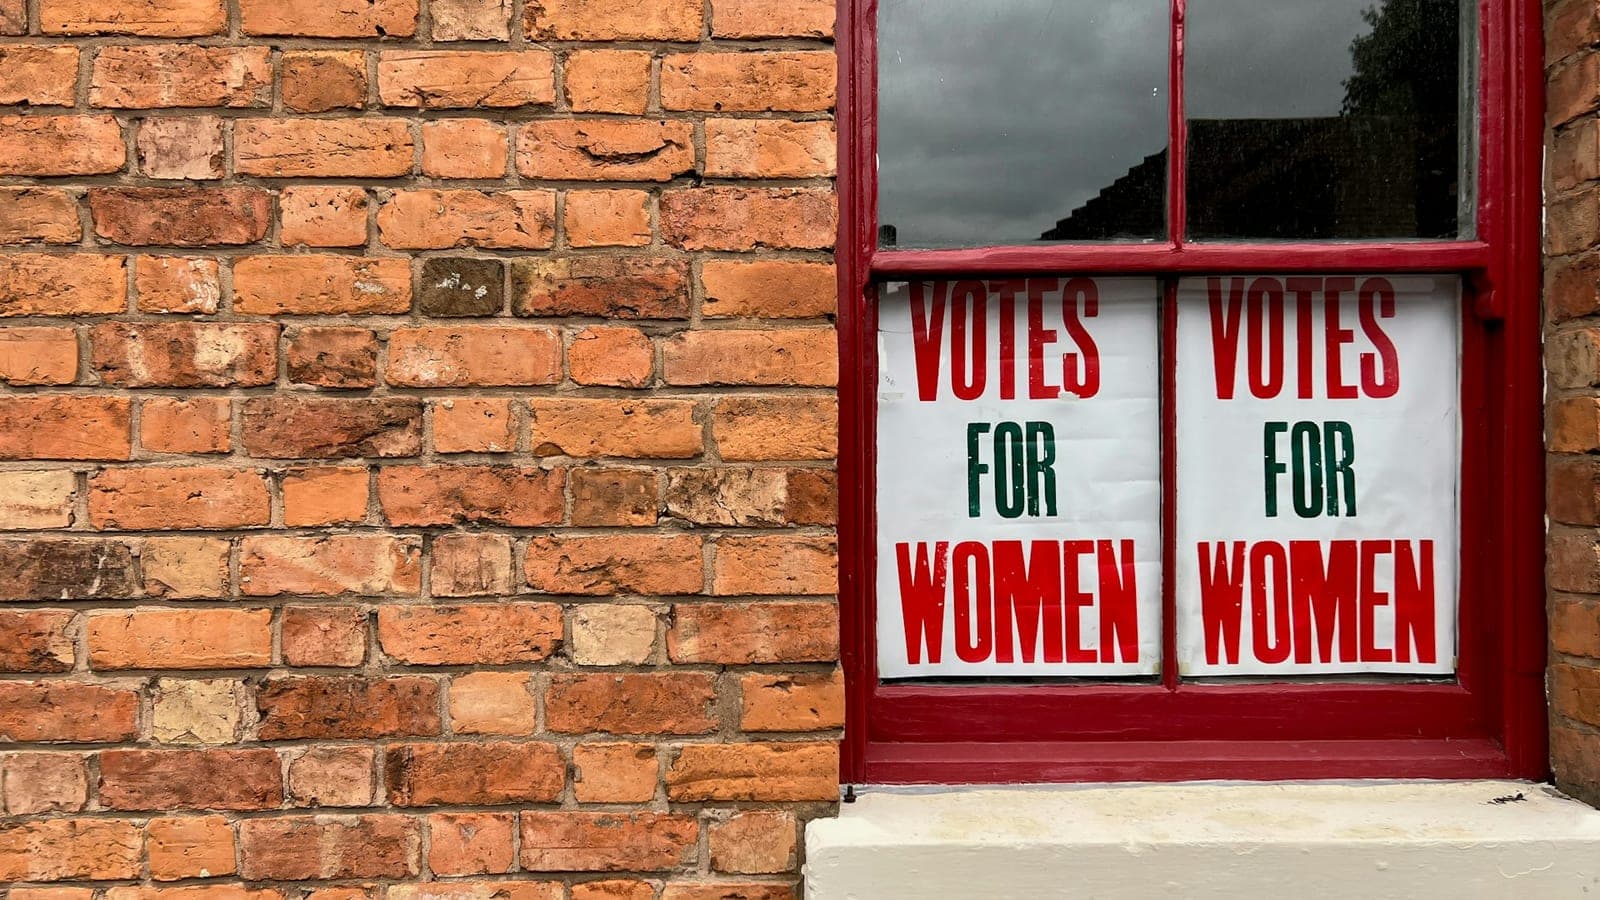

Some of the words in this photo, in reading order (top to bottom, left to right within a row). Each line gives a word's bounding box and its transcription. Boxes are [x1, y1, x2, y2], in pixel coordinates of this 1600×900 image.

[909, 277, 1100, 401] VOTES
[1208, 277, 1400, 400] VOTES
[967, 421, 1058, 518] FOR
[1264, 421, 1357, 518] FOR
[896, 539, 1139, 664] WOMEN
[1197, 540, 1436, 664] WOMEN
